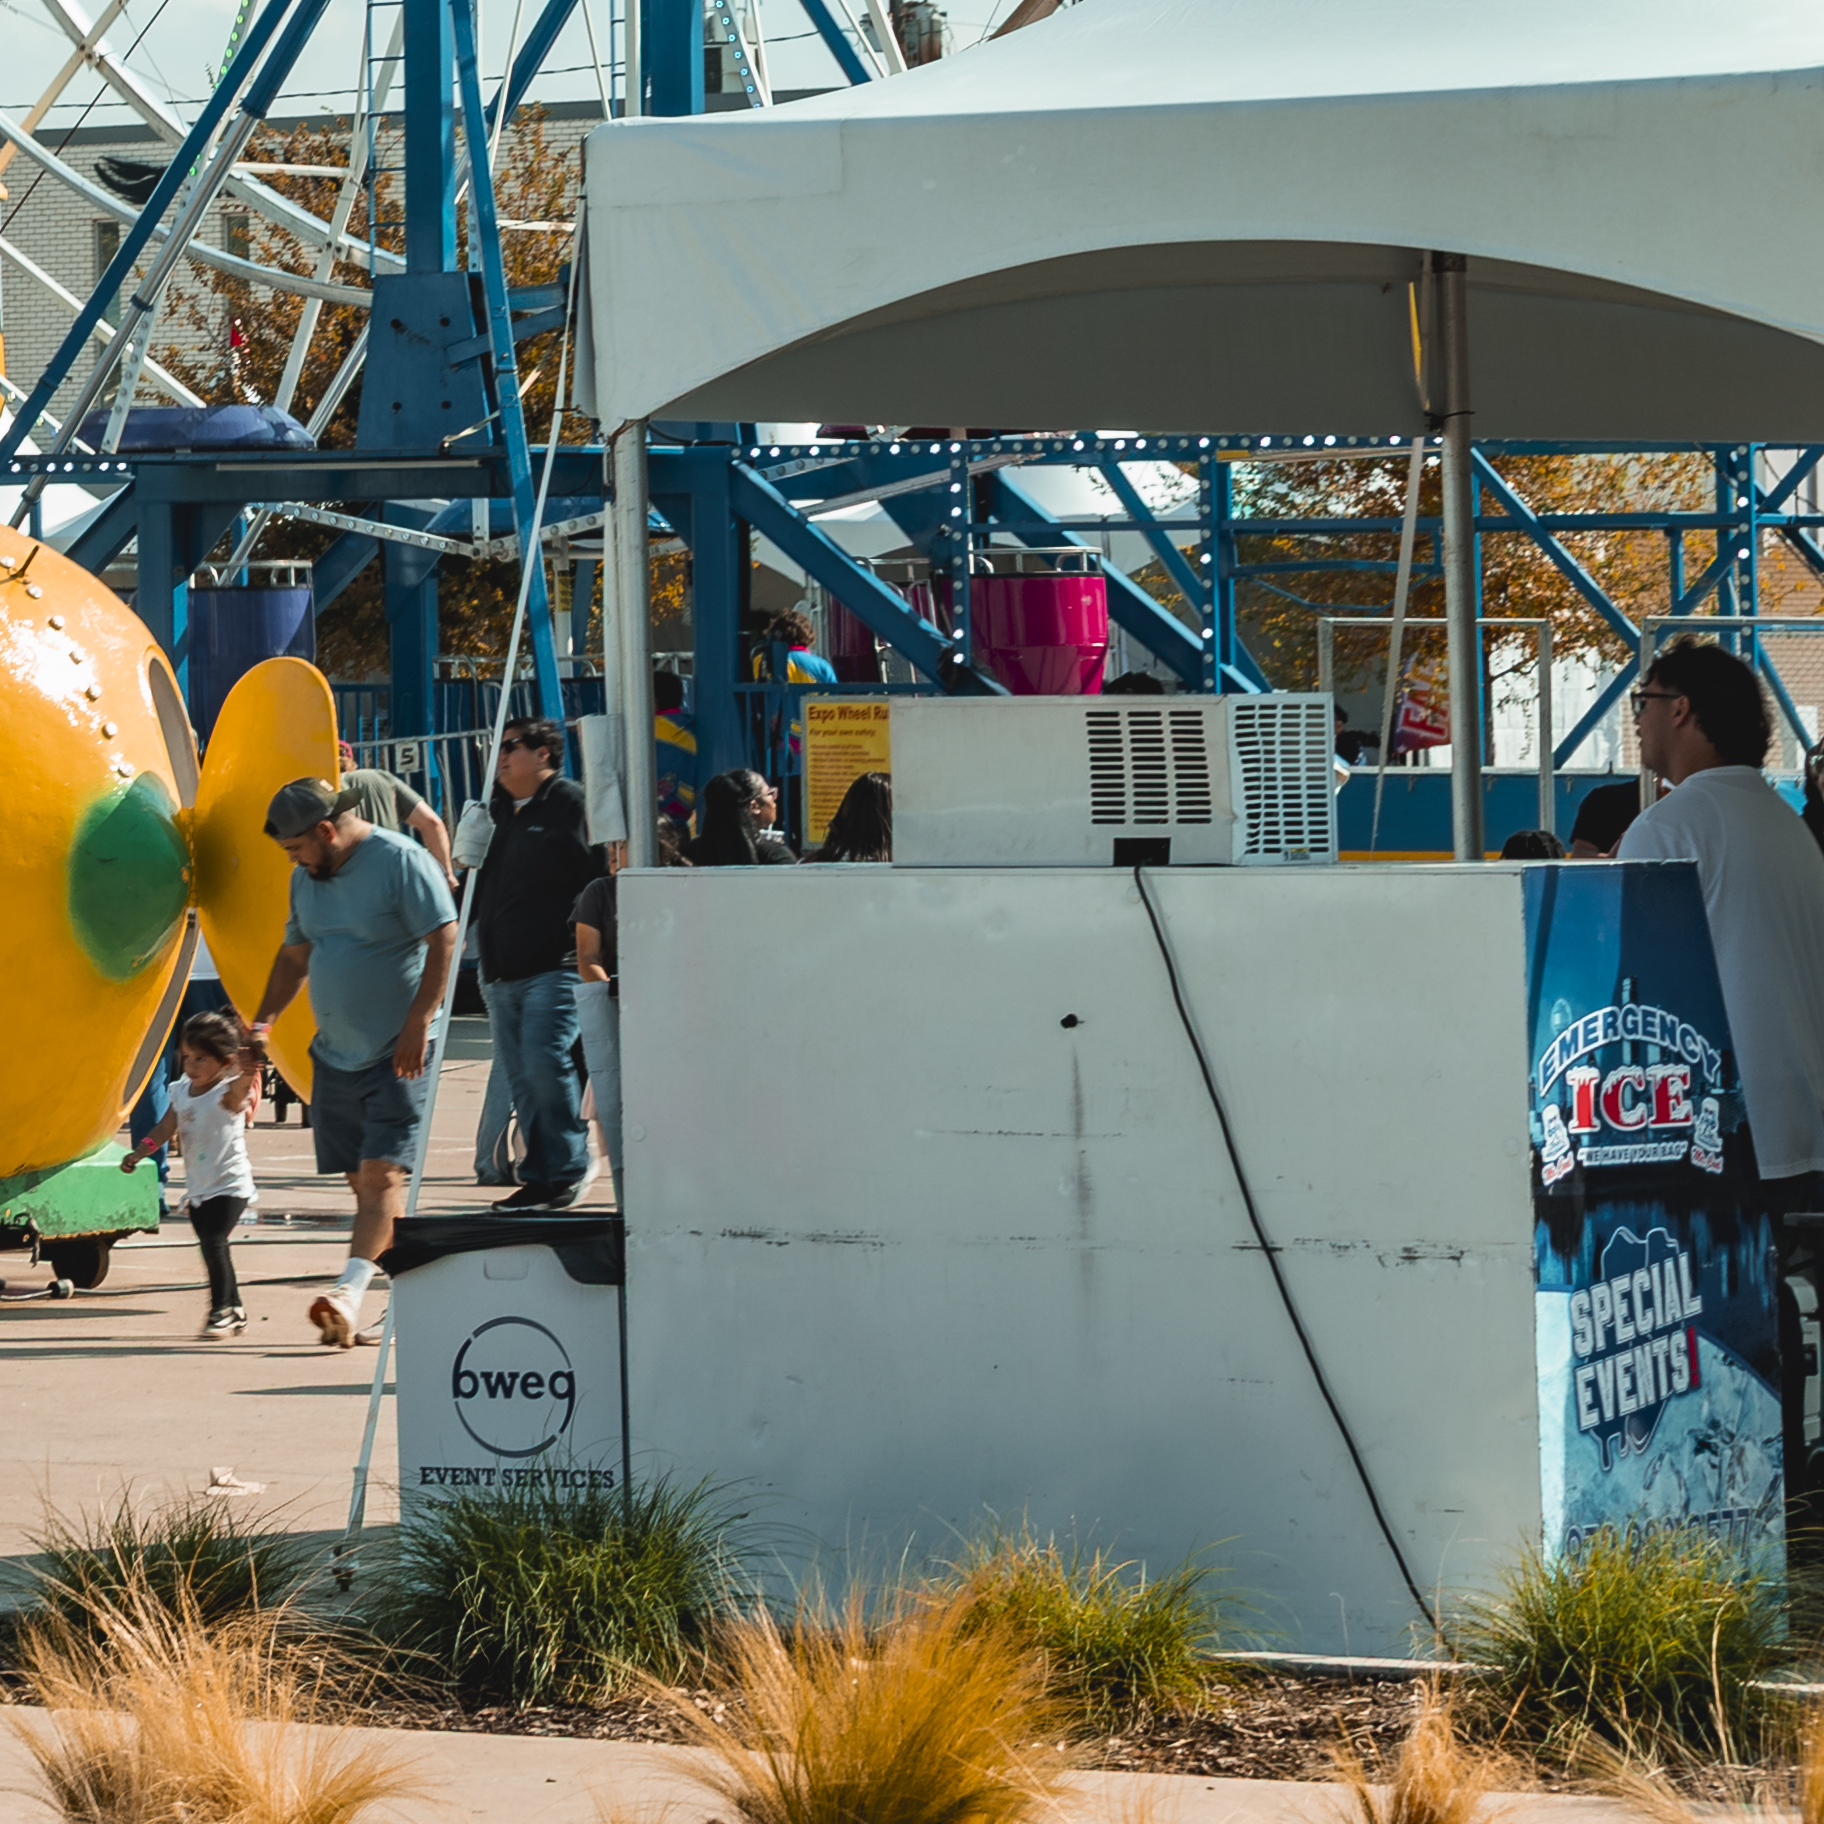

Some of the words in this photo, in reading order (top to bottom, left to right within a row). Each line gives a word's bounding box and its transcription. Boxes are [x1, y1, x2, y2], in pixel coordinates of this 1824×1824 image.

[809, 706, 835, 723] Expo
[838, 706, 871, 720] Wheel
[400, 747, 414, 766] 5
[1539, 1004, 1721, 1097] EMERGENCY
[1566, 1063, 1694, 1134] ICE
[1569, 1252, 1702, 1358] SPECIAL
[452, 1368, 576, 1408] bweg
[1574, 1325, 1701, 1432] EVENTS!
[420, 1466, 496, 1486] EVENT
[503, 1468, 615, 1489] SERVICES
